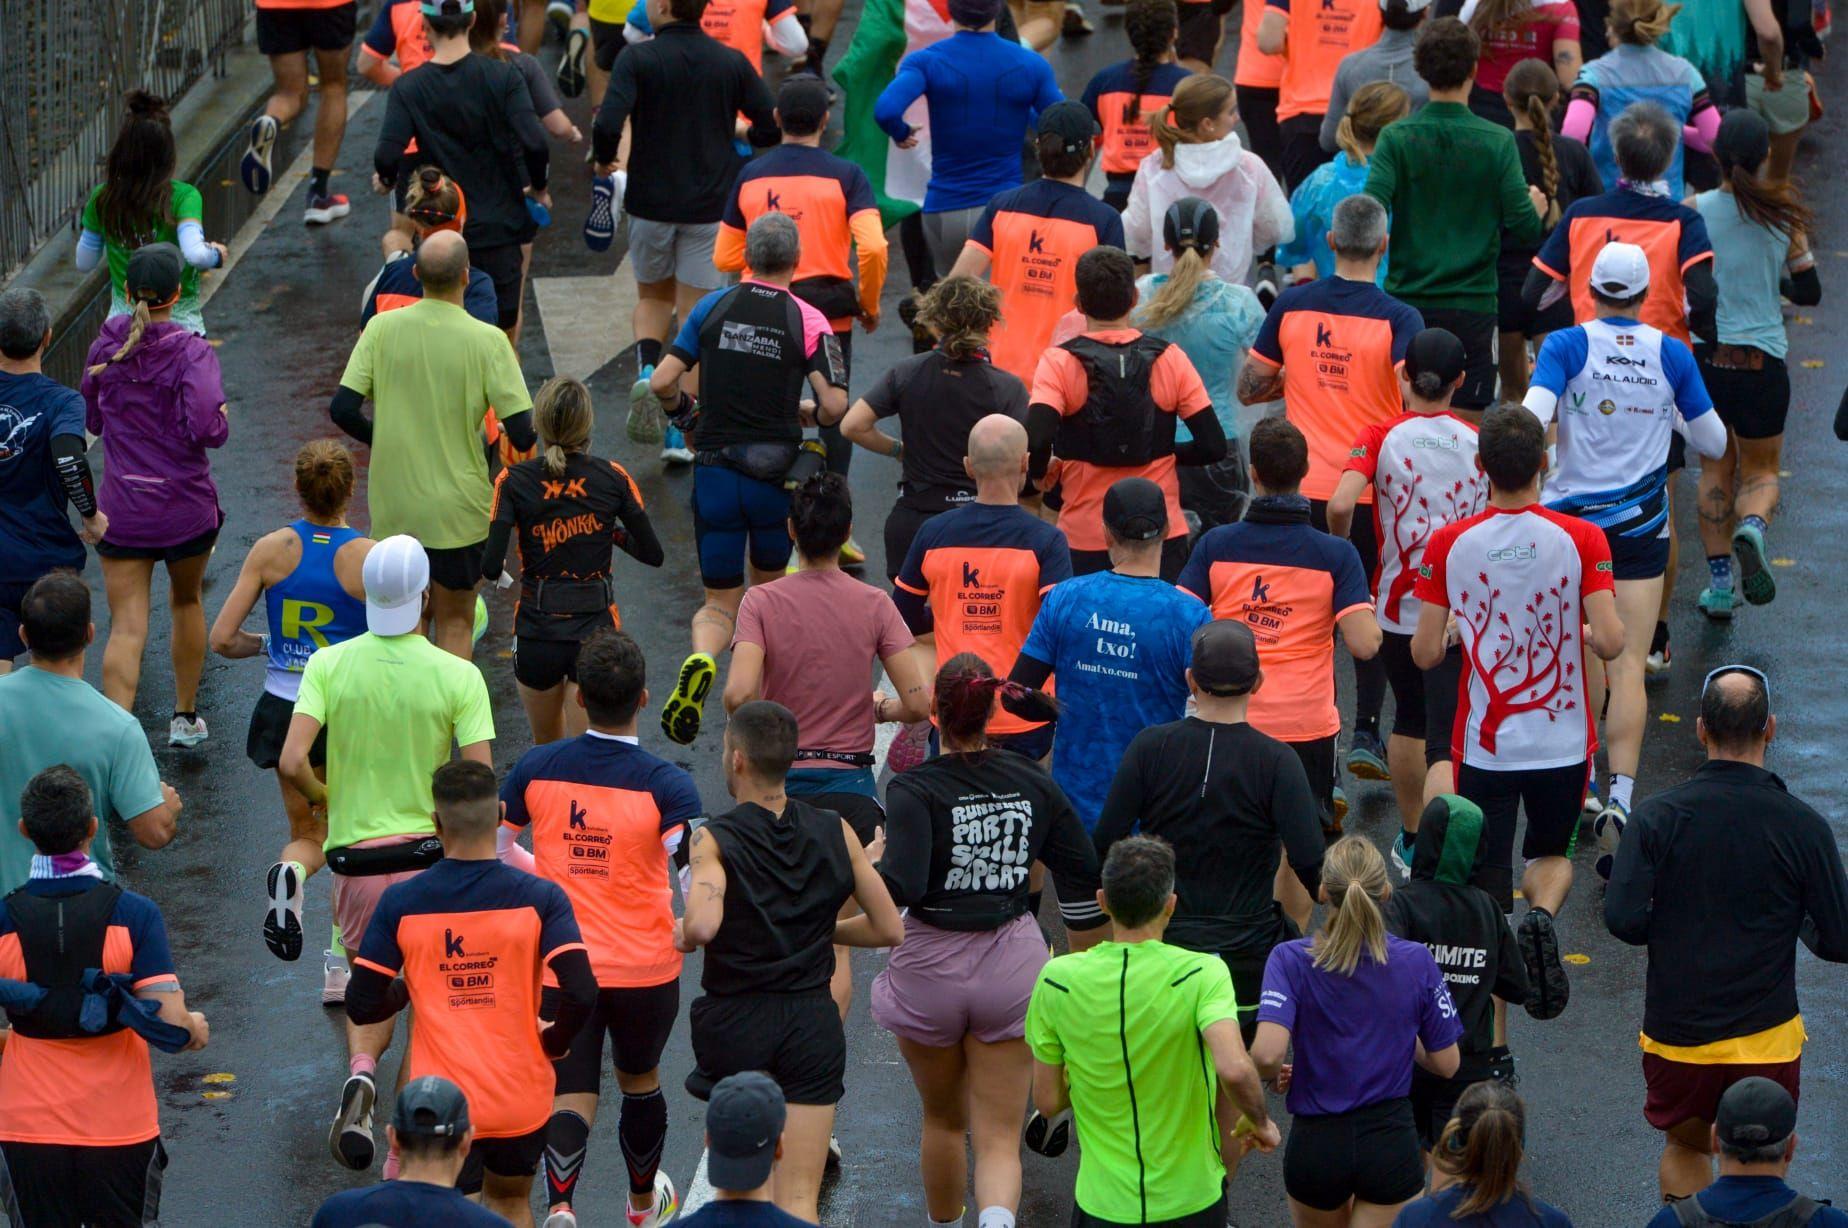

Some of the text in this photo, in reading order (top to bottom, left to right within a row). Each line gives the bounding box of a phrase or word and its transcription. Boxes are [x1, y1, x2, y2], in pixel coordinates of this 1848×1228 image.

[1330, 365, 1344, 376] BM
[532, 512, 603, 553] WONKA
[1487, 542, 1537, 562] cobi
[963, 562, 980, 589] k
[957, 592, 1003, 600] EL CORREO
[1252, 575, 1270, 604] k
[979, 605, 997, 615] BM
[1085, 611, 1136, 639] Ama,
[1260, 616, 1281, 629] BM
[1096, 637, 1137, 659] txo!
[1074, 660, 1138, 680] Amatxo.com
[570, 800, 587, 830] k
[951, 800, 1032, 825] RUNNING
[952, 810, 1033, 845] PARTY
[563, 833, 611, 845] EL CORREO
[587, 848, 606, 859] BM
[951, 835, 1029, 867] SMILE
[445, 928, 465, 958] k
[439, 960, 495, 971] EL CORREO
[467, 975, 488, 987] BM
[1443, 972, 1480, 985] BOXING
